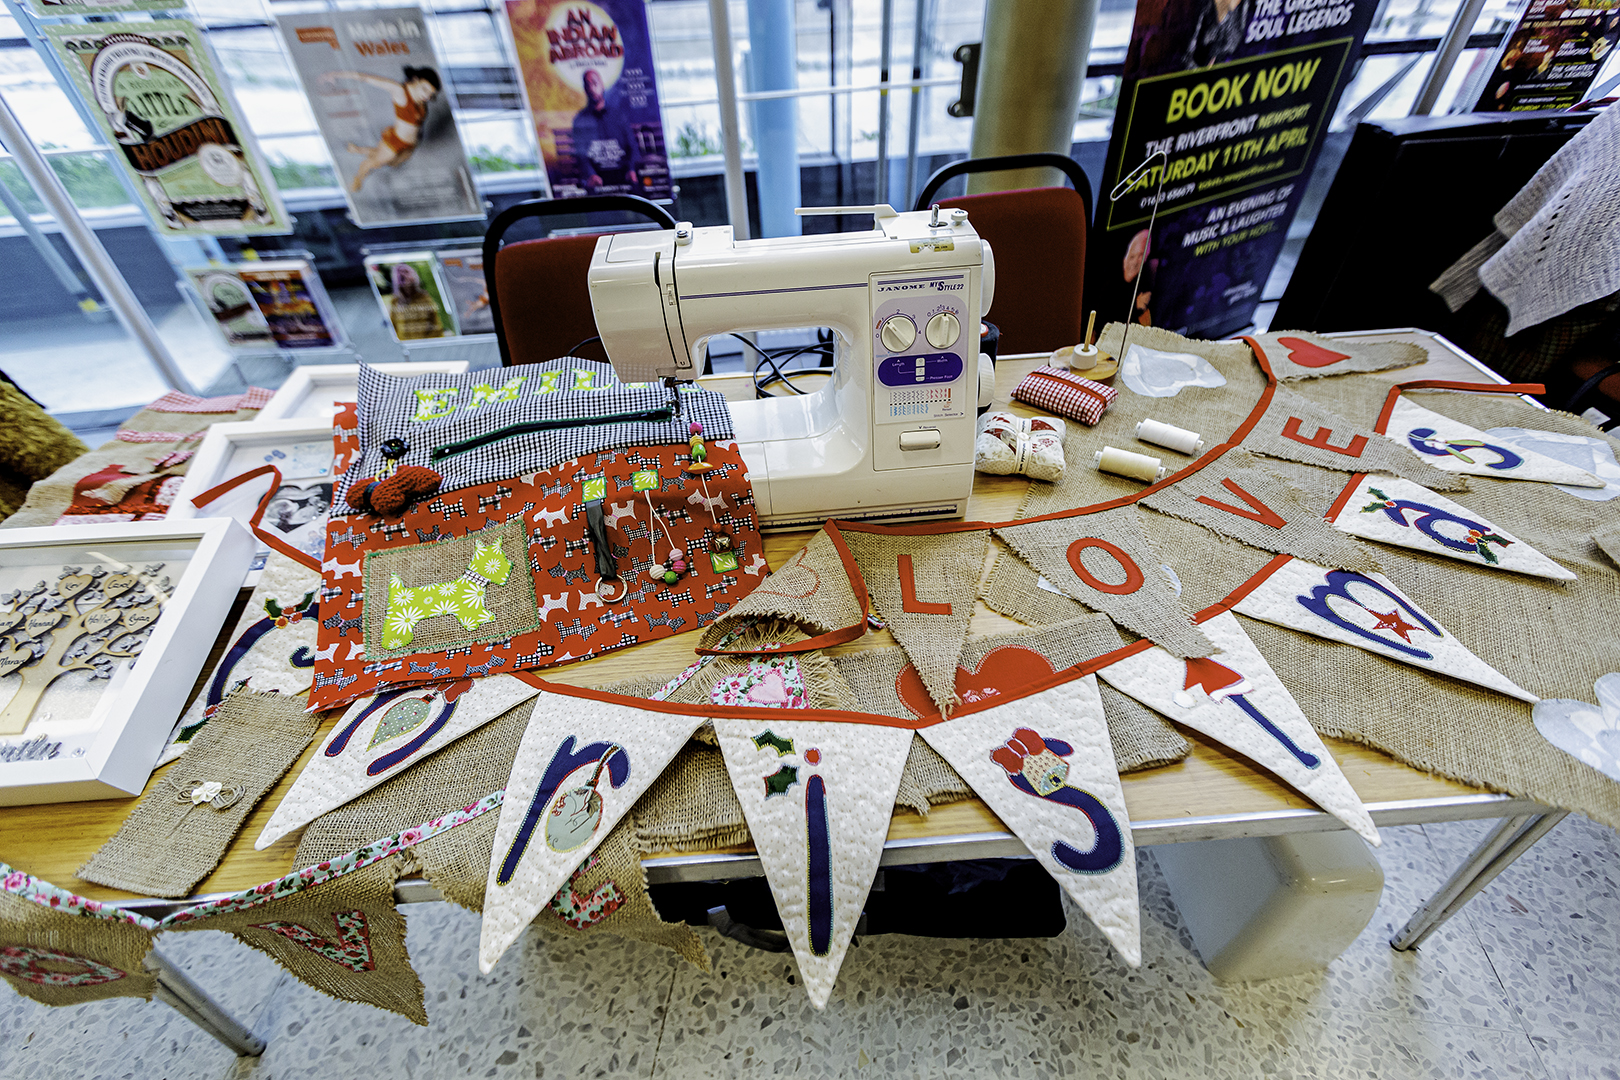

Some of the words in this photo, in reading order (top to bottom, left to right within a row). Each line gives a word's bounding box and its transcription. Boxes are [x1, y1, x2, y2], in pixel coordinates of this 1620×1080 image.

[546, 24, 617, 47] INDIAN
[567, 8, 592, 29] AN
[1245, 16, 1286, 44] SOUL
[1286, 3, 1355, 36] LEGENDS
[354, 39, 411, 57] Wales
[549, 42, 624, 64] ABROAD
[1166, 73, 1251, 125] BOOK
[1250, 57, 1322, 104] NOW
[131, 117, 231, 171] HOUDINI
[1144, 135, 1175, 158] THE
[1174, 114, 1260, 152] RIVERFRONT
[1256, 103, 1312, 130] NEWPORT
[1125, 149, 1221, 195] SATURDAY
[1221, 137, 1265, 167] 11TH
[1262, 125, 1310, 154] APRIL
[1205, 206, 1228, 224] AN
[1225, 189, 1277, 216] EVENING
[1276, 183, 1296, 201] OF
[1181, 223, 1220, 248] MUSIC
[1230, 201, 1289, 232] LAUGHTER
[877, 284, 926, 292] JANOME
